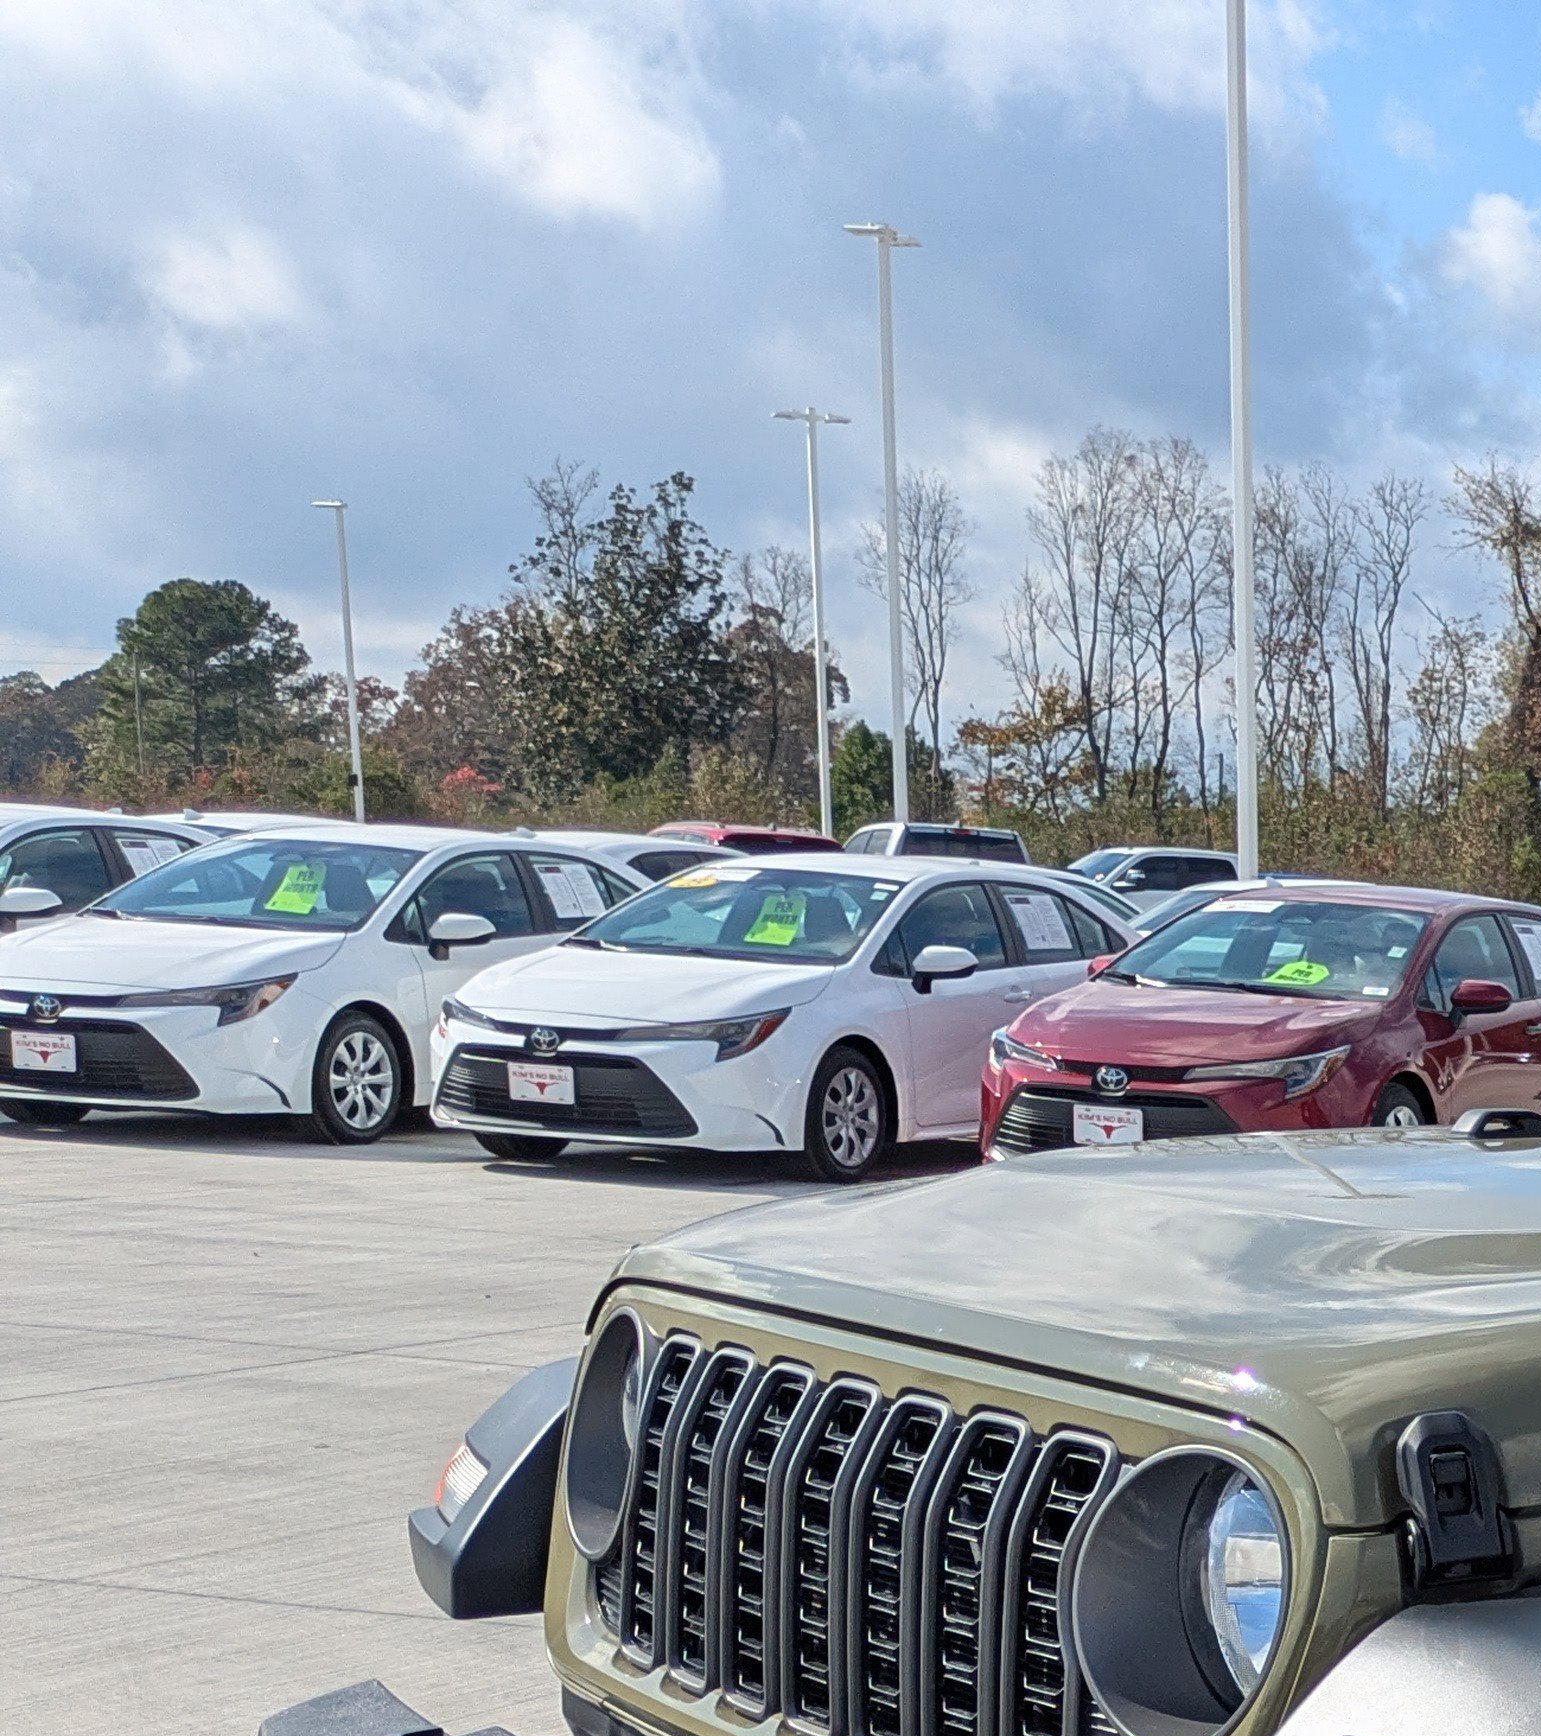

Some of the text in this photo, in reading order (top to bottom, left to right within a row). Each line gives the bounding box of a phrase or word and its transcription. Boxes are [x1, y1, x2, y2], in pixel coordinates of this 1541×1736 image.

[296, 870, 315, 881] PER
[39, 1041, 51, 1049] NO
[52, 1041, 72, 1050] BULL
[549, 1073, 570, 1082] BULL
[1103, 1115, 1116, 1123] NO
[1117, 1116, 1138, 1125] BULL
